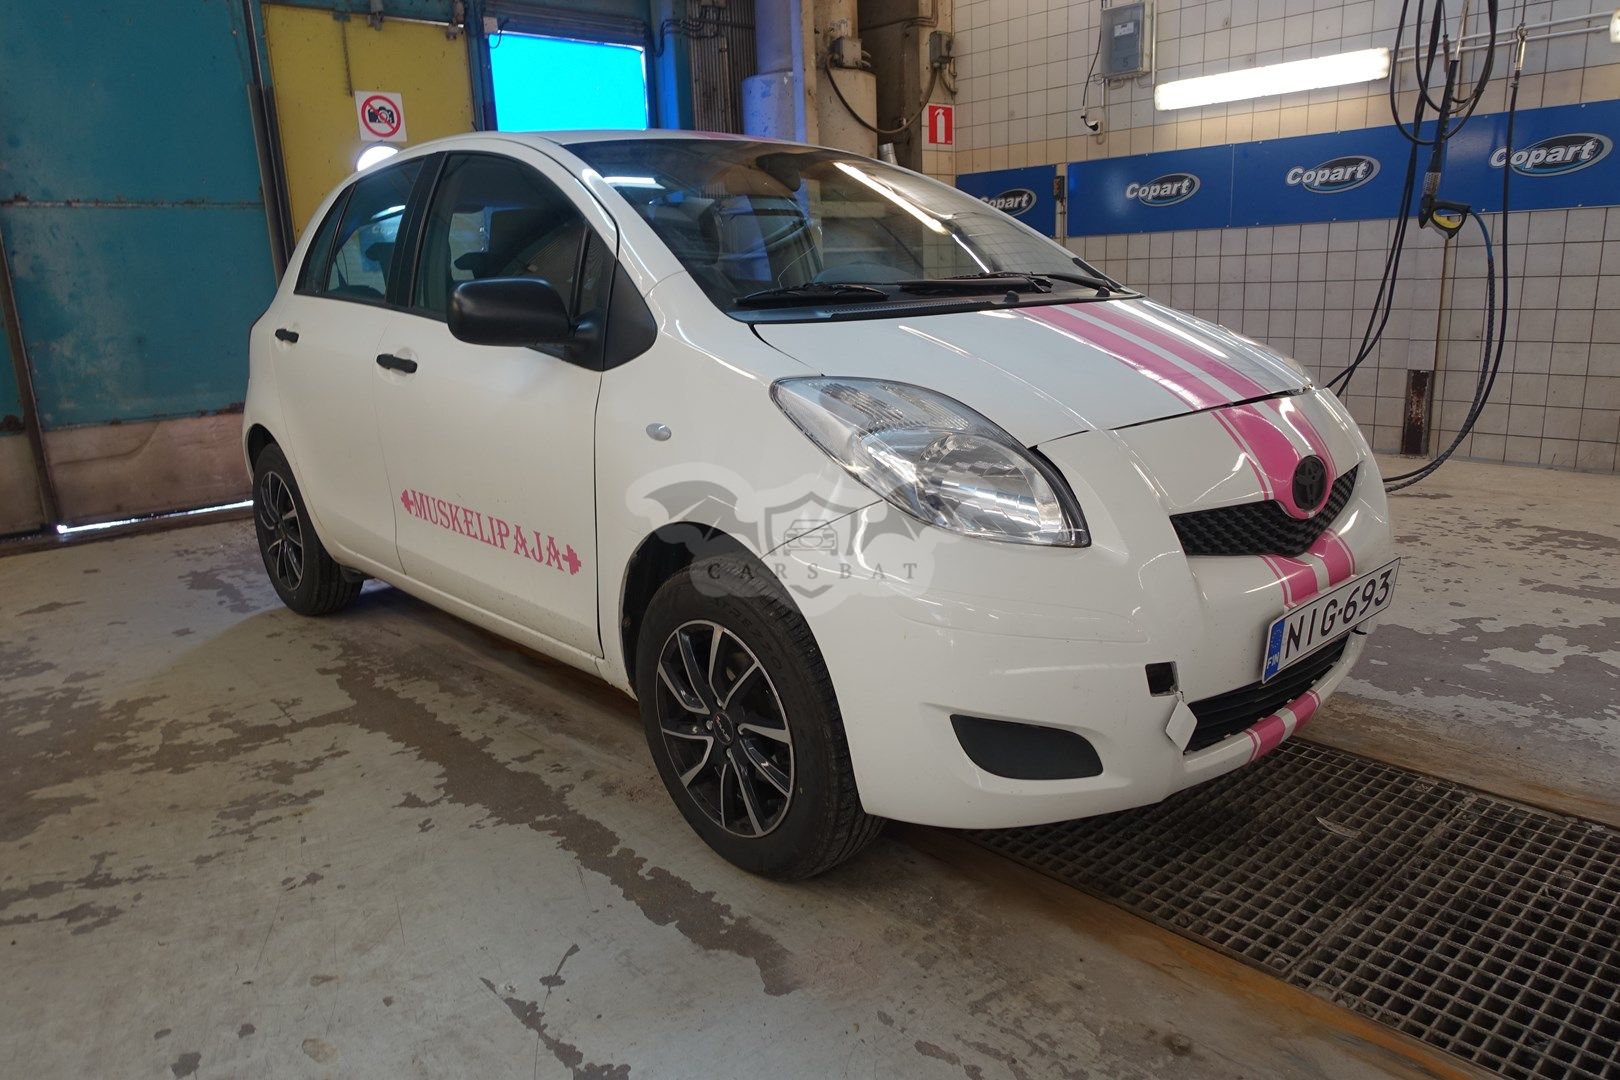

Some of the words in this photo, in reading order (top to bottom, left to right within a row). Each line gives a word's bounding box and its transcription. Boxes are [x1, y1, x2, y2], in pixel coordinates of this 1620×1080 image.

[1490, 140, 1596, 169] Copart
[1286, 161, 1368, 187] Copart
[1126, 178, 1191, 200] Copart
[410, 490, 565, 571] MUSKELIPAJA
[1285, 568, 1393, 660] NIG-693
[1266, 652, 1280, 669] FIN
